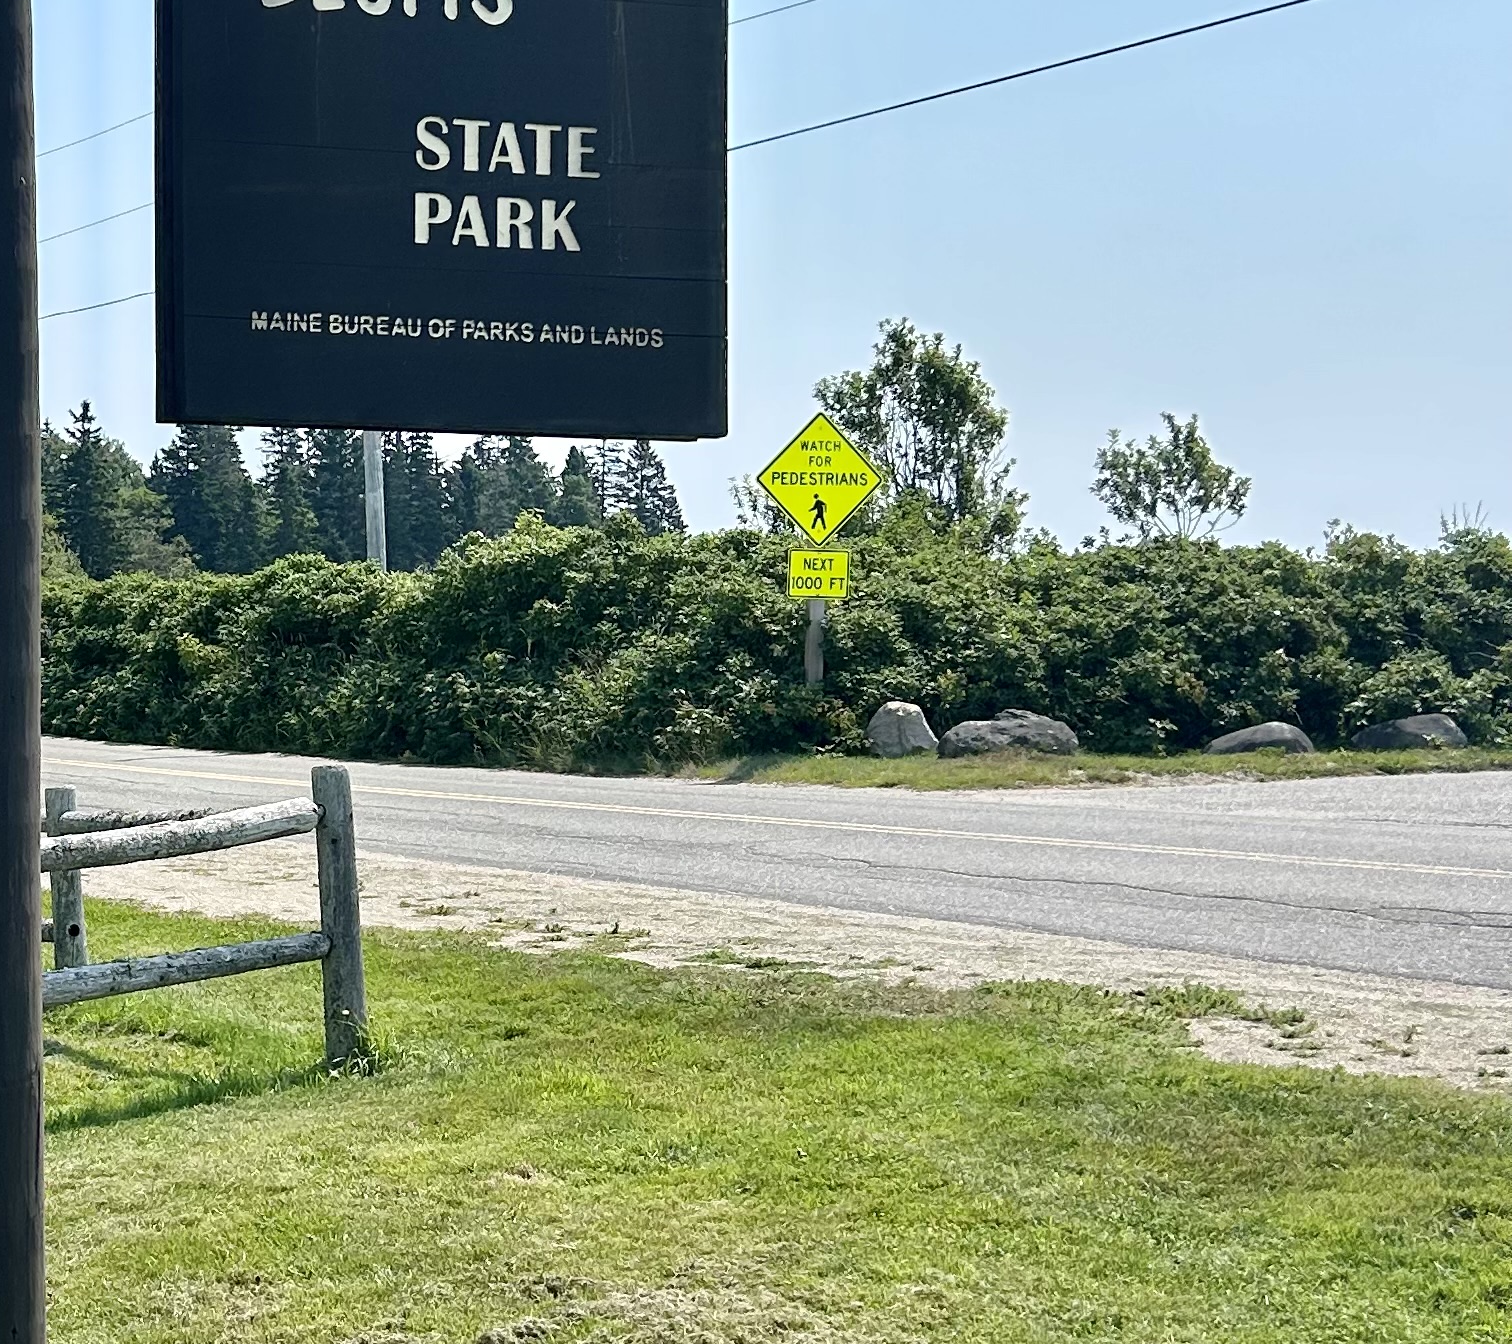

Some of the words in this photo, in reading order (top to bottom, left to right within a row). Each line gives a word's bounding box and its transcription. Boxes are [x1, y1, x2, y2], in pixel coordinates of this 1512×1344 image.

[415, 116, 601, 179] STATE
[414, 192, 581, 252] PARK
[251, 311, 323, 333] MAINE
[328, 314, 423, 338] BUREAU
[428, 318, 457, 339] OF
[462, 319, 535, 343] PARKS
[539, 323, 585, 344] AND
[590, 326, 664, 348] LANDS
[800, 440, 842, 452] WATCH
[808, 455, 832, 467] FOR
[771, 471, 868, 486] PEDESTRIANS
[803, 558, 834, 571] NEXT
[791, 576, 823, 590] 1000
[829, 577, 846, 590] FT
